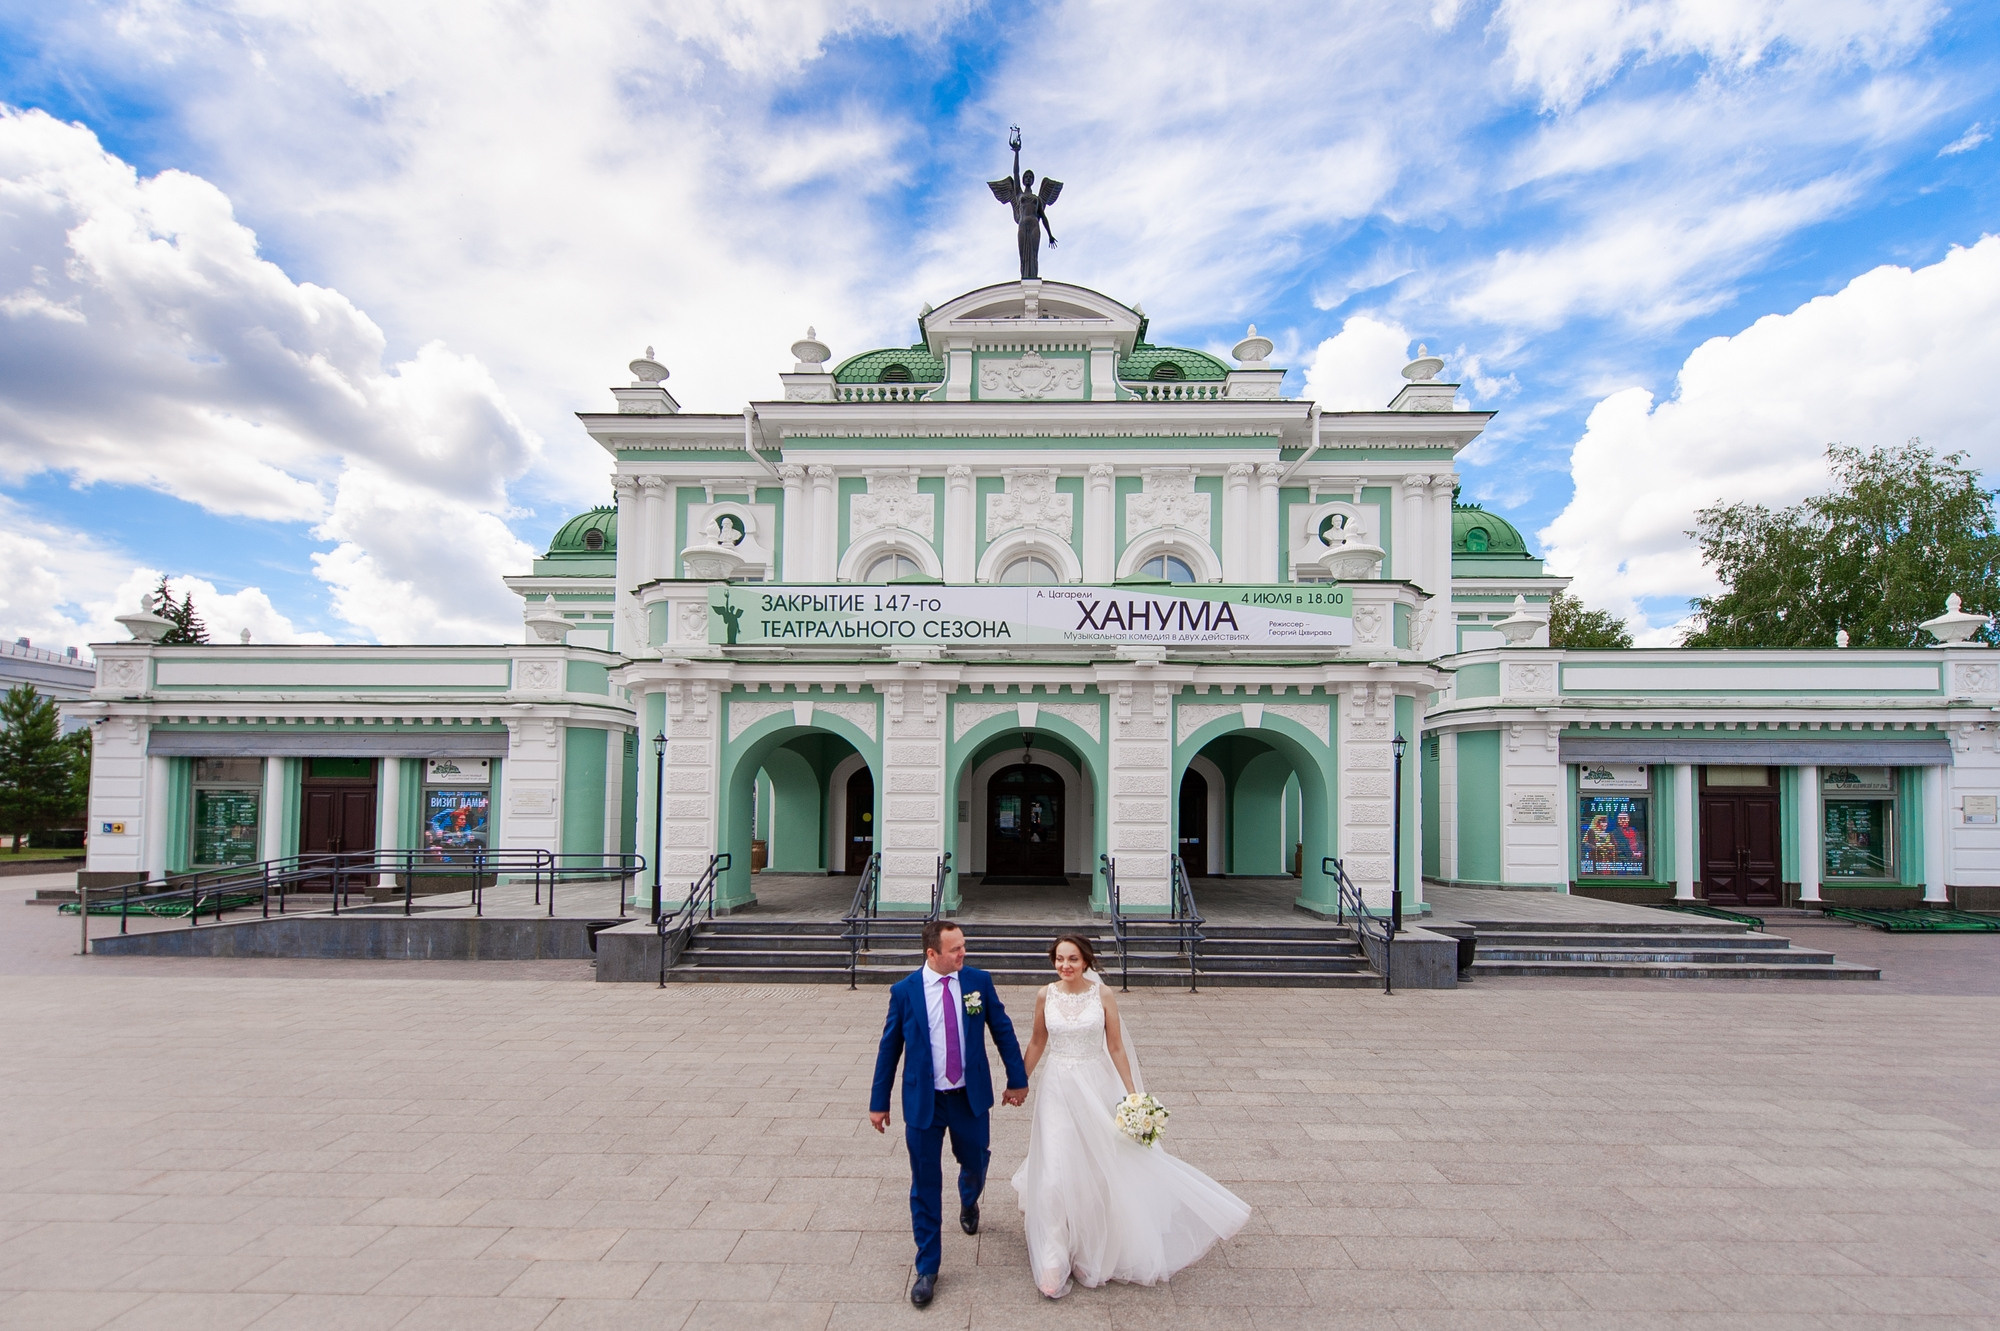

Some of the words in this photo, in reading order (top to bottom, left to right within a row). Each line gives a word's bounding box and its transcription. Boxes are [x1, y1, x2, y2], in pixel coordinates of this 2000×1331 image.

[1036, 590, 1045, 598] А.
[1048, 590, 1093, 600] Цагарели
[1241, 592, 1249, 604] 4
[1253, 592, 1292, 604] ИЮЛЯ
[1296, 595, 1303, 604] в
[1308, 593, 1344, 604] 18.00
[761, 594, 864, 612] ЗАКРЫТИЕ
[874, 594, 942, 612] 147-го
[1075, 600, 1239, 631] ХАНУМА
[761, 620, 916, 638] ТЕАТРАЛЬНОГО
[923, 620, 1011, 638] СЕЗОНА
[1268, 620, 1304, 628] Режиссер
[1063, 631, 1127, 641] Музыкальная
[1128, 633, 1170, 641] комедия
[1178, 633, 1200, 642] двух
[1201, 632, 1250, 641] действиях
[1268, 629, 1297, 637] Георгий
[430, 797, 457, 808] ВИЗИТ
[460, 797, 486, 808] ДАМЫ
[1590, 803, 1636, 812] ХАНУМА
